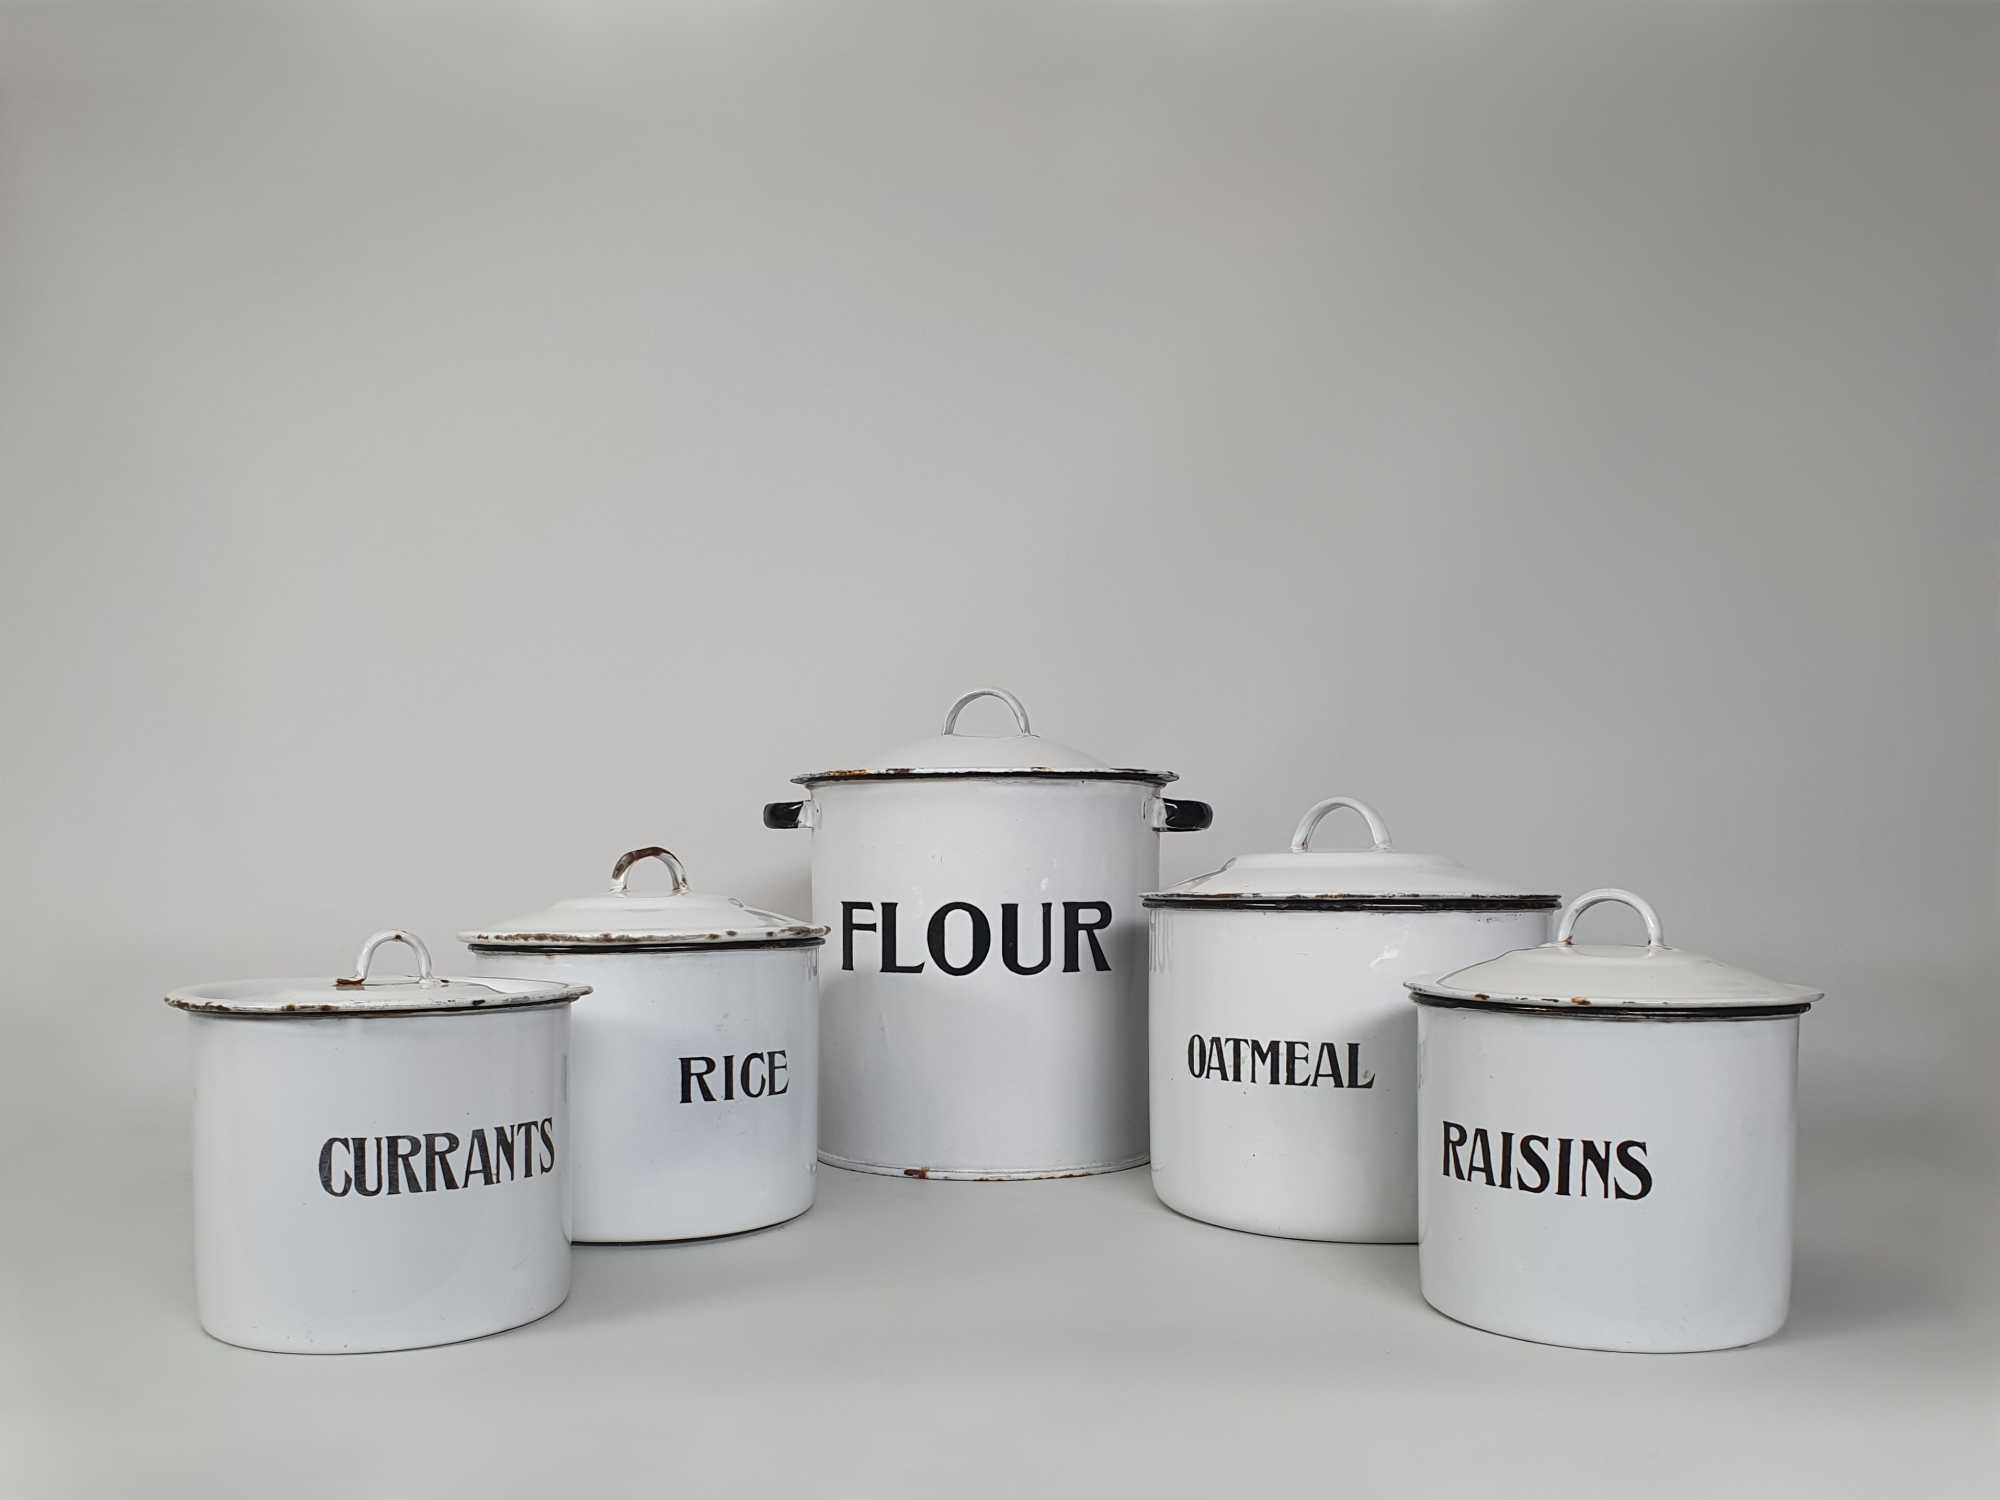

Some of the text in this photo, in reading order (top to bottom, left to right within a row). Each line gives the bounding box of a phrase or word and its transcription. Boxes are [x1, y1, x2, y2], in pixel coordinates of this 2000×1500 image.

[841, 900, 1113, 977] FLOUR
[679, 1049, 790, 1104] RICE
[1187, 1034, 1376, 1090] OATMEAL
[318, 1116, 555, 1198] CURRANTS
[1442, 1120, 1653, 1201] RAISINS
